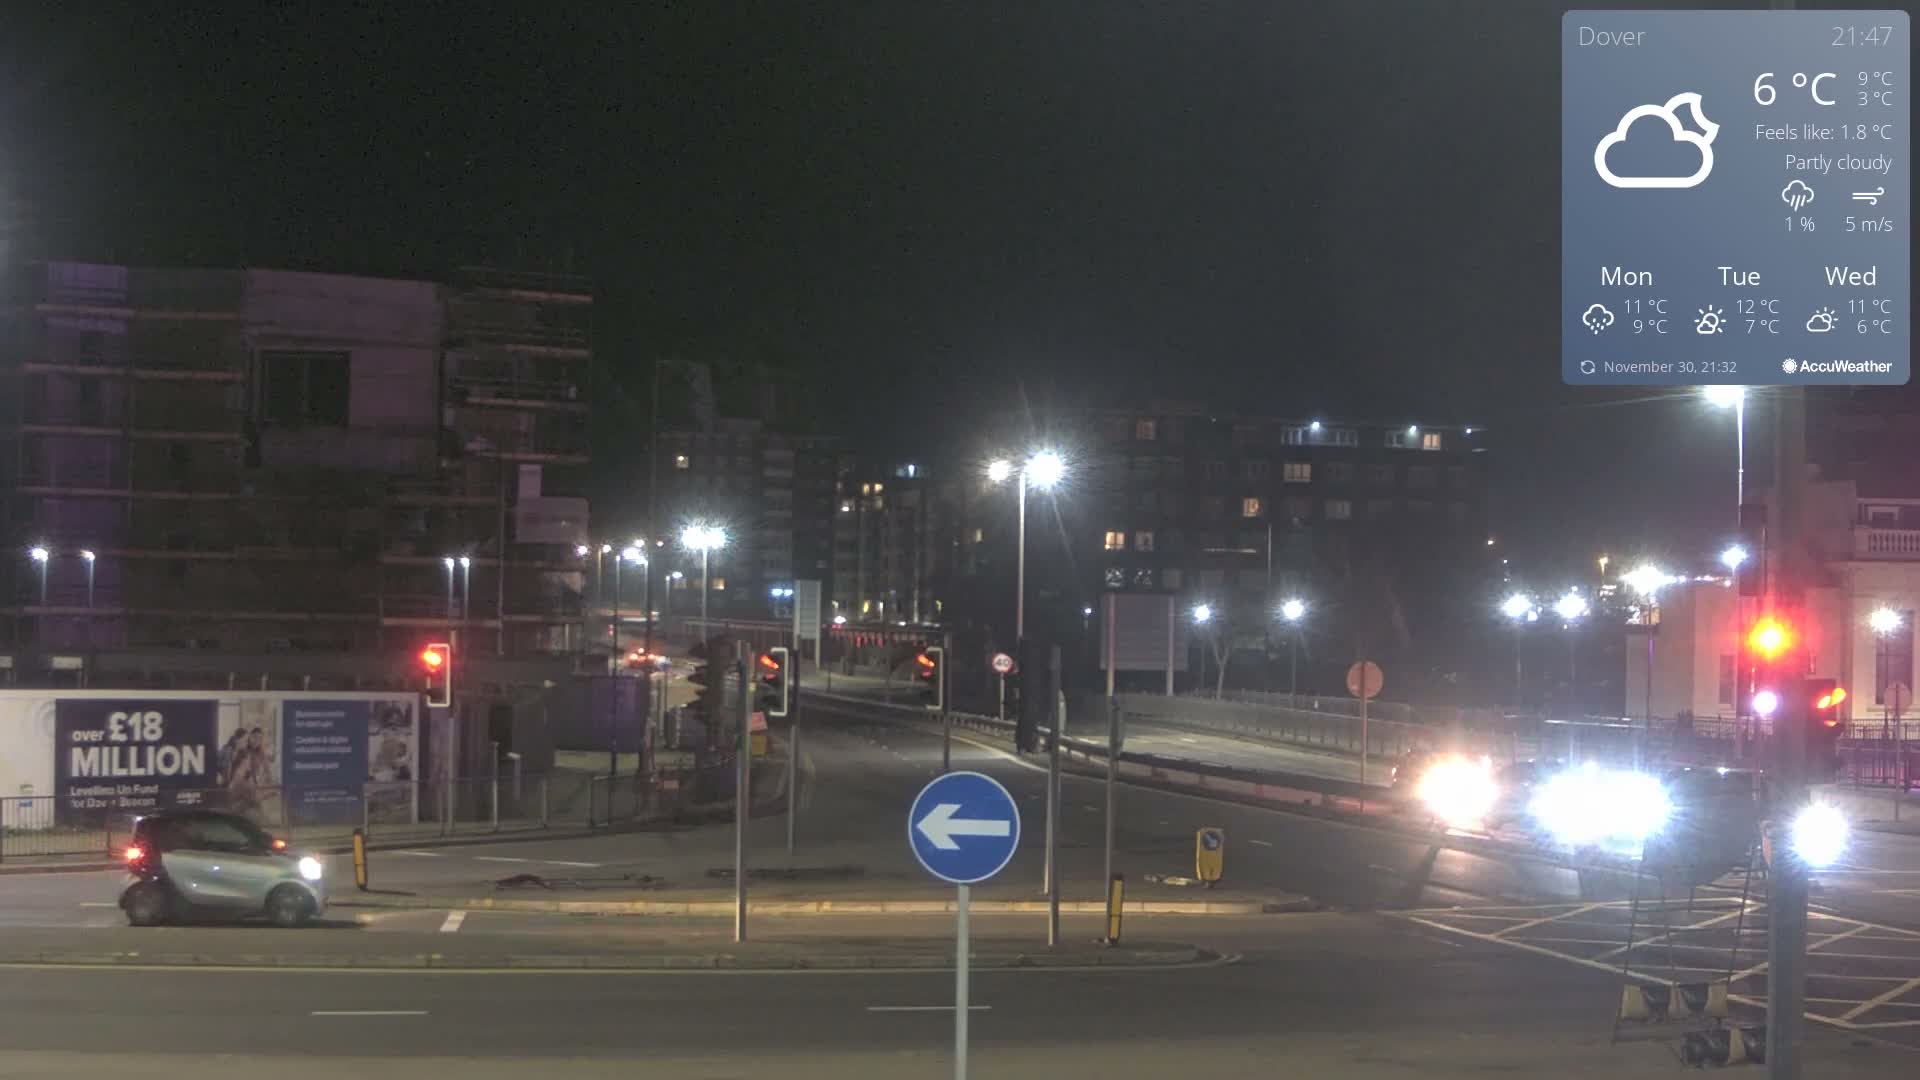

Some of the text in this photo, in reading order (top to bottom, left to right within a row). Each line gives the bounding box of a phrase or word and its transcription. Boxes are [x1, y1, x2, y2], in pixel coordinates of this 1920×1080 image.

[997, 658, 1009, 667] 40
[72, 711, 163, 742] over £18
[71, 745, 206, 777] MILLION
